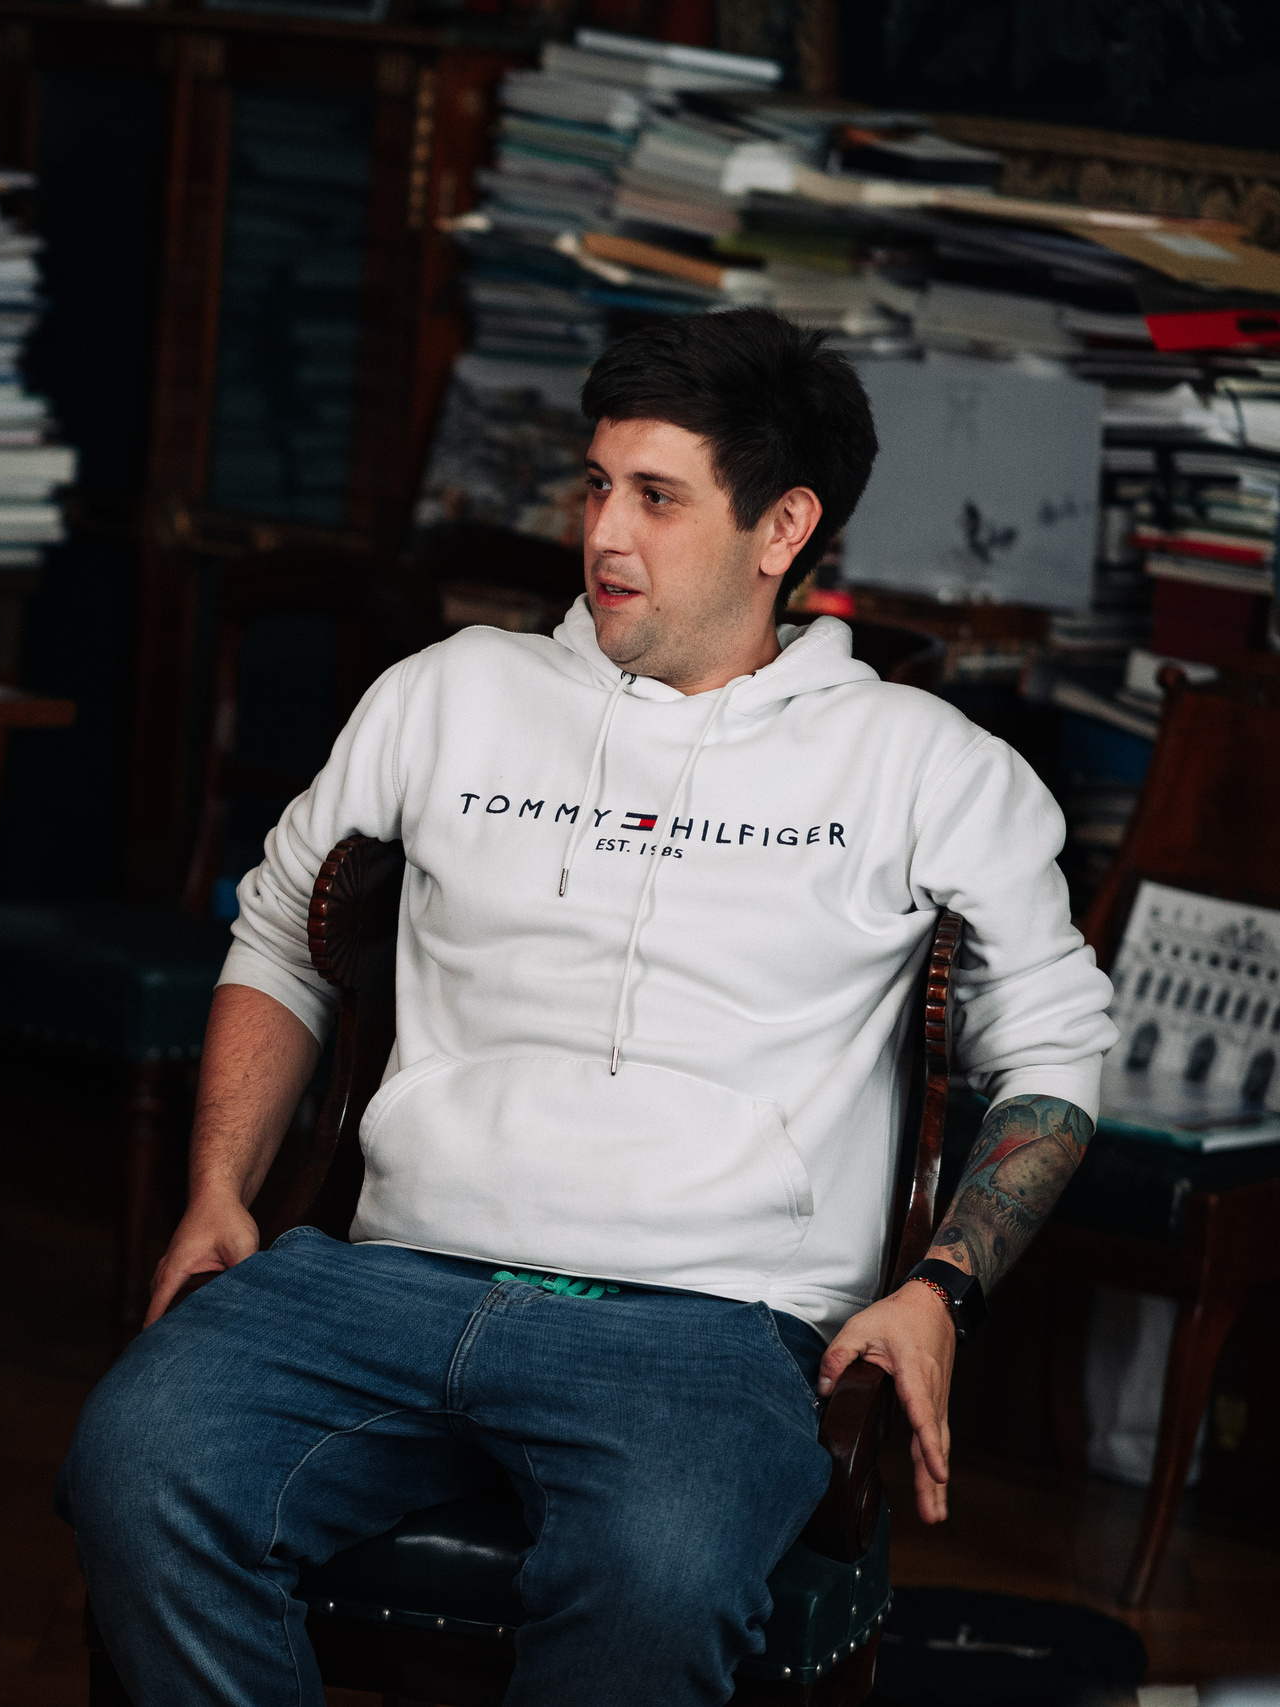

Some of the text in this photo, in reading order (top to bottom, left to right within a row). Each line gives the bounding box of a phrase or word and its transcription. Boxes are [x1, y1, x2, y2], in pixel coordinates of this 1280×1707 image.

[460, 793, 847, 848] TOMMY HILFIGER
[595, 838, 631, 853] EST.
